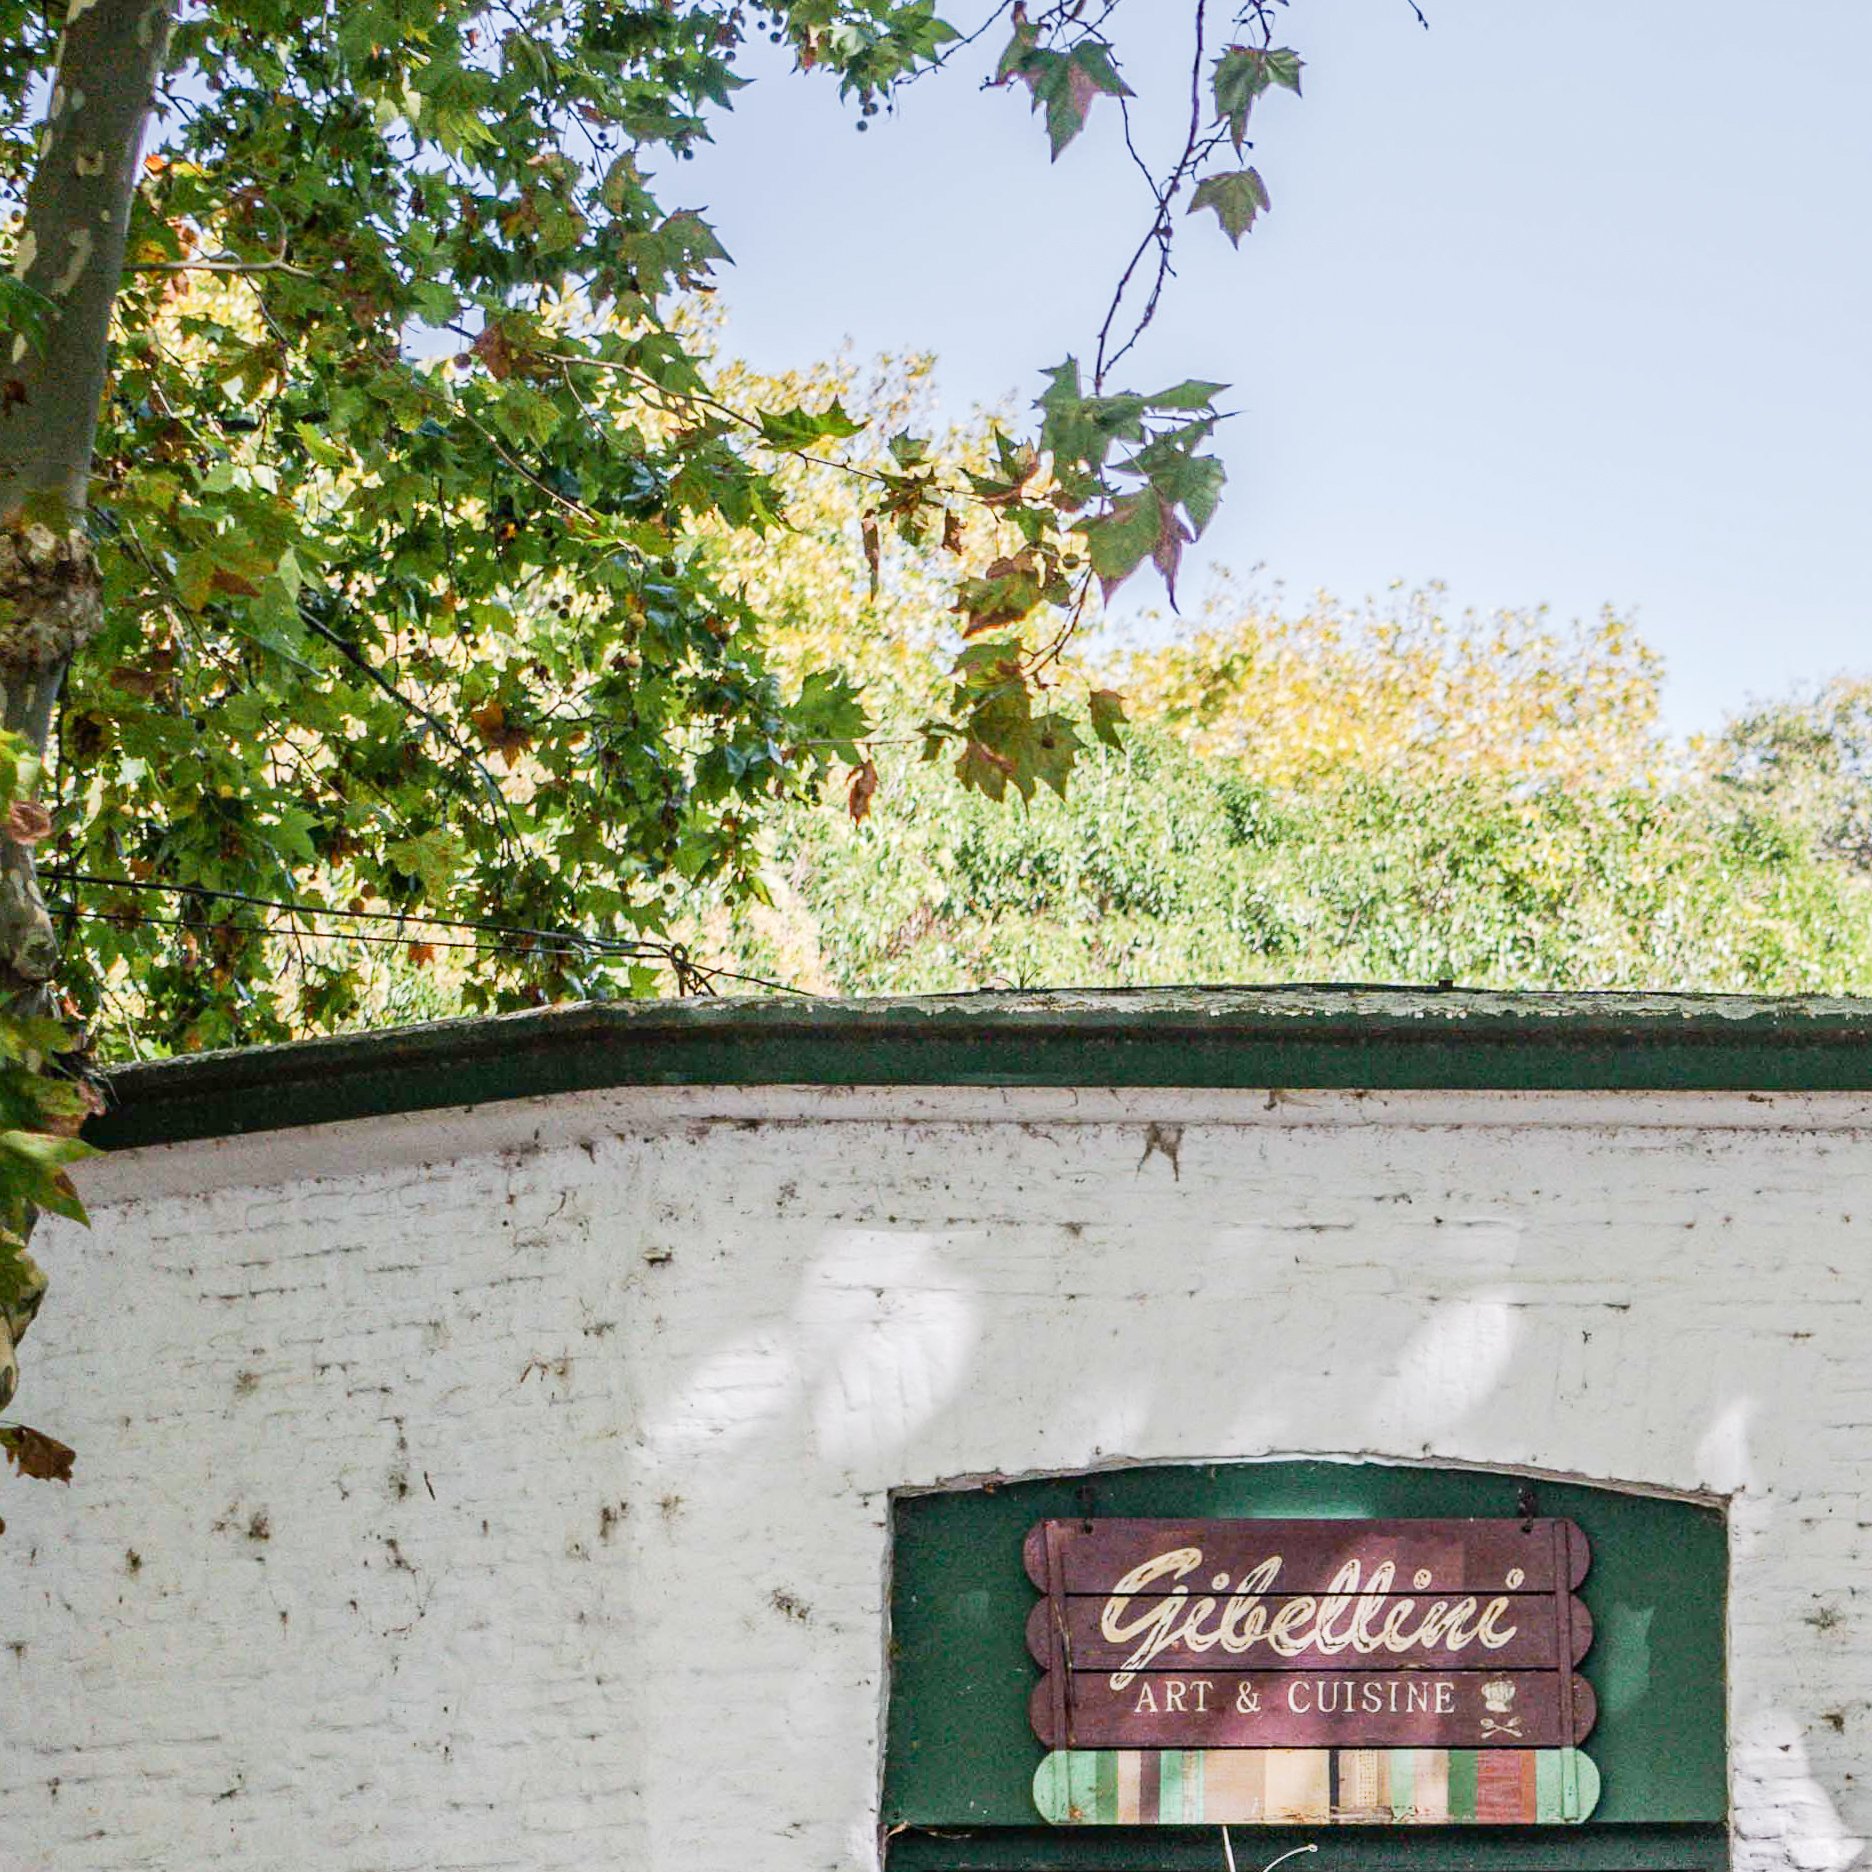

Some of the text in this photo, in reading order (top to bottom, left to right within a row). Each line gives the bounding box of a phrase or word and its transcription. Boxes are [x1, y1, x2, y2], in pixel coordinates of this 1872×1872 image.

[1100, 1546, 1524, 1690] Gibellini
[1134, 1680, 1456, 1714] ART & CUISINE
